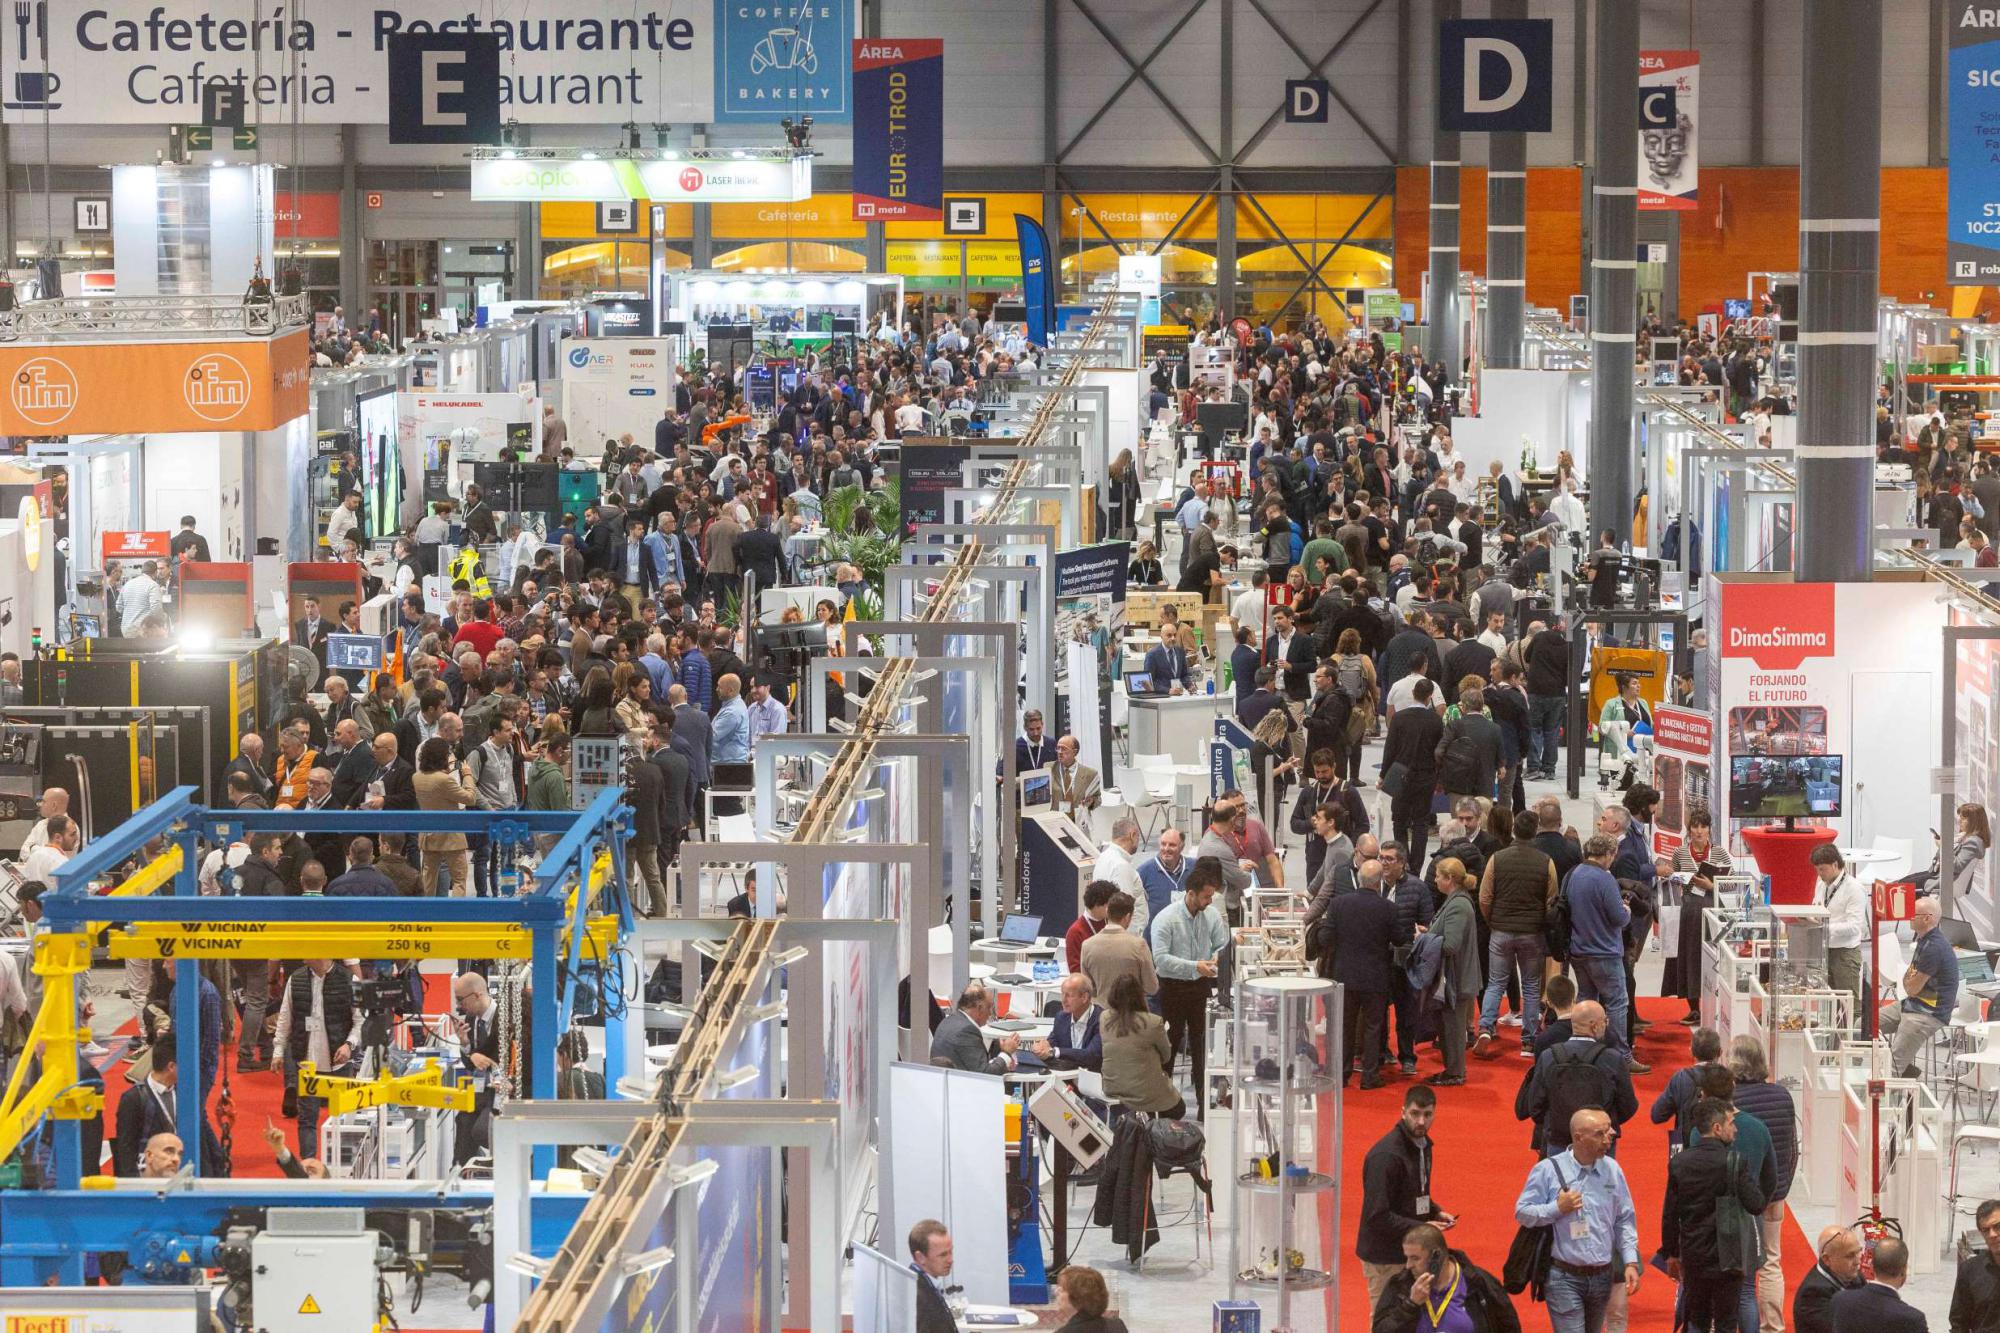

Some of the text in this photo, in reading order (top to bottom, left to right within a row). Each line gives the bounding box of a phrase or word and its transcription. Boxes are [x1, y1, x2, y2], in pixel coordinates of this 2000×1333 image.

[1959, 5, 2000, 28] ÁR
[76, 7, 315, 52] Cafetería
[859, 43, 904, 59] ÁREA
[1463, 37, 1528, 113] D
[422, 51, 467, 125] E
[739, 88, 830, 99] BAKERY
[215, 91, 232, 121] F
[1294, 86, 1320, 116] D
[1643, 92, 1667, 123] C
[878, 204, 907, 214] metal
[1640, 196, 1666, 205] metal
[19, 366, 71, 408] ifm
[190, 362, 244, 406] ifm
[1730, 627, 1827, 647] DimaSimma
[1750, 675, 1807, 686] FORJANDO
[1749, 691, 1808, 701] EL FUTURO
[207, 923, 267, 933] VICINAY
[182, 938, 243, 950] VICINAY
[386, 939, 410, 950] 250
[414, 939, 430, 953] kg
